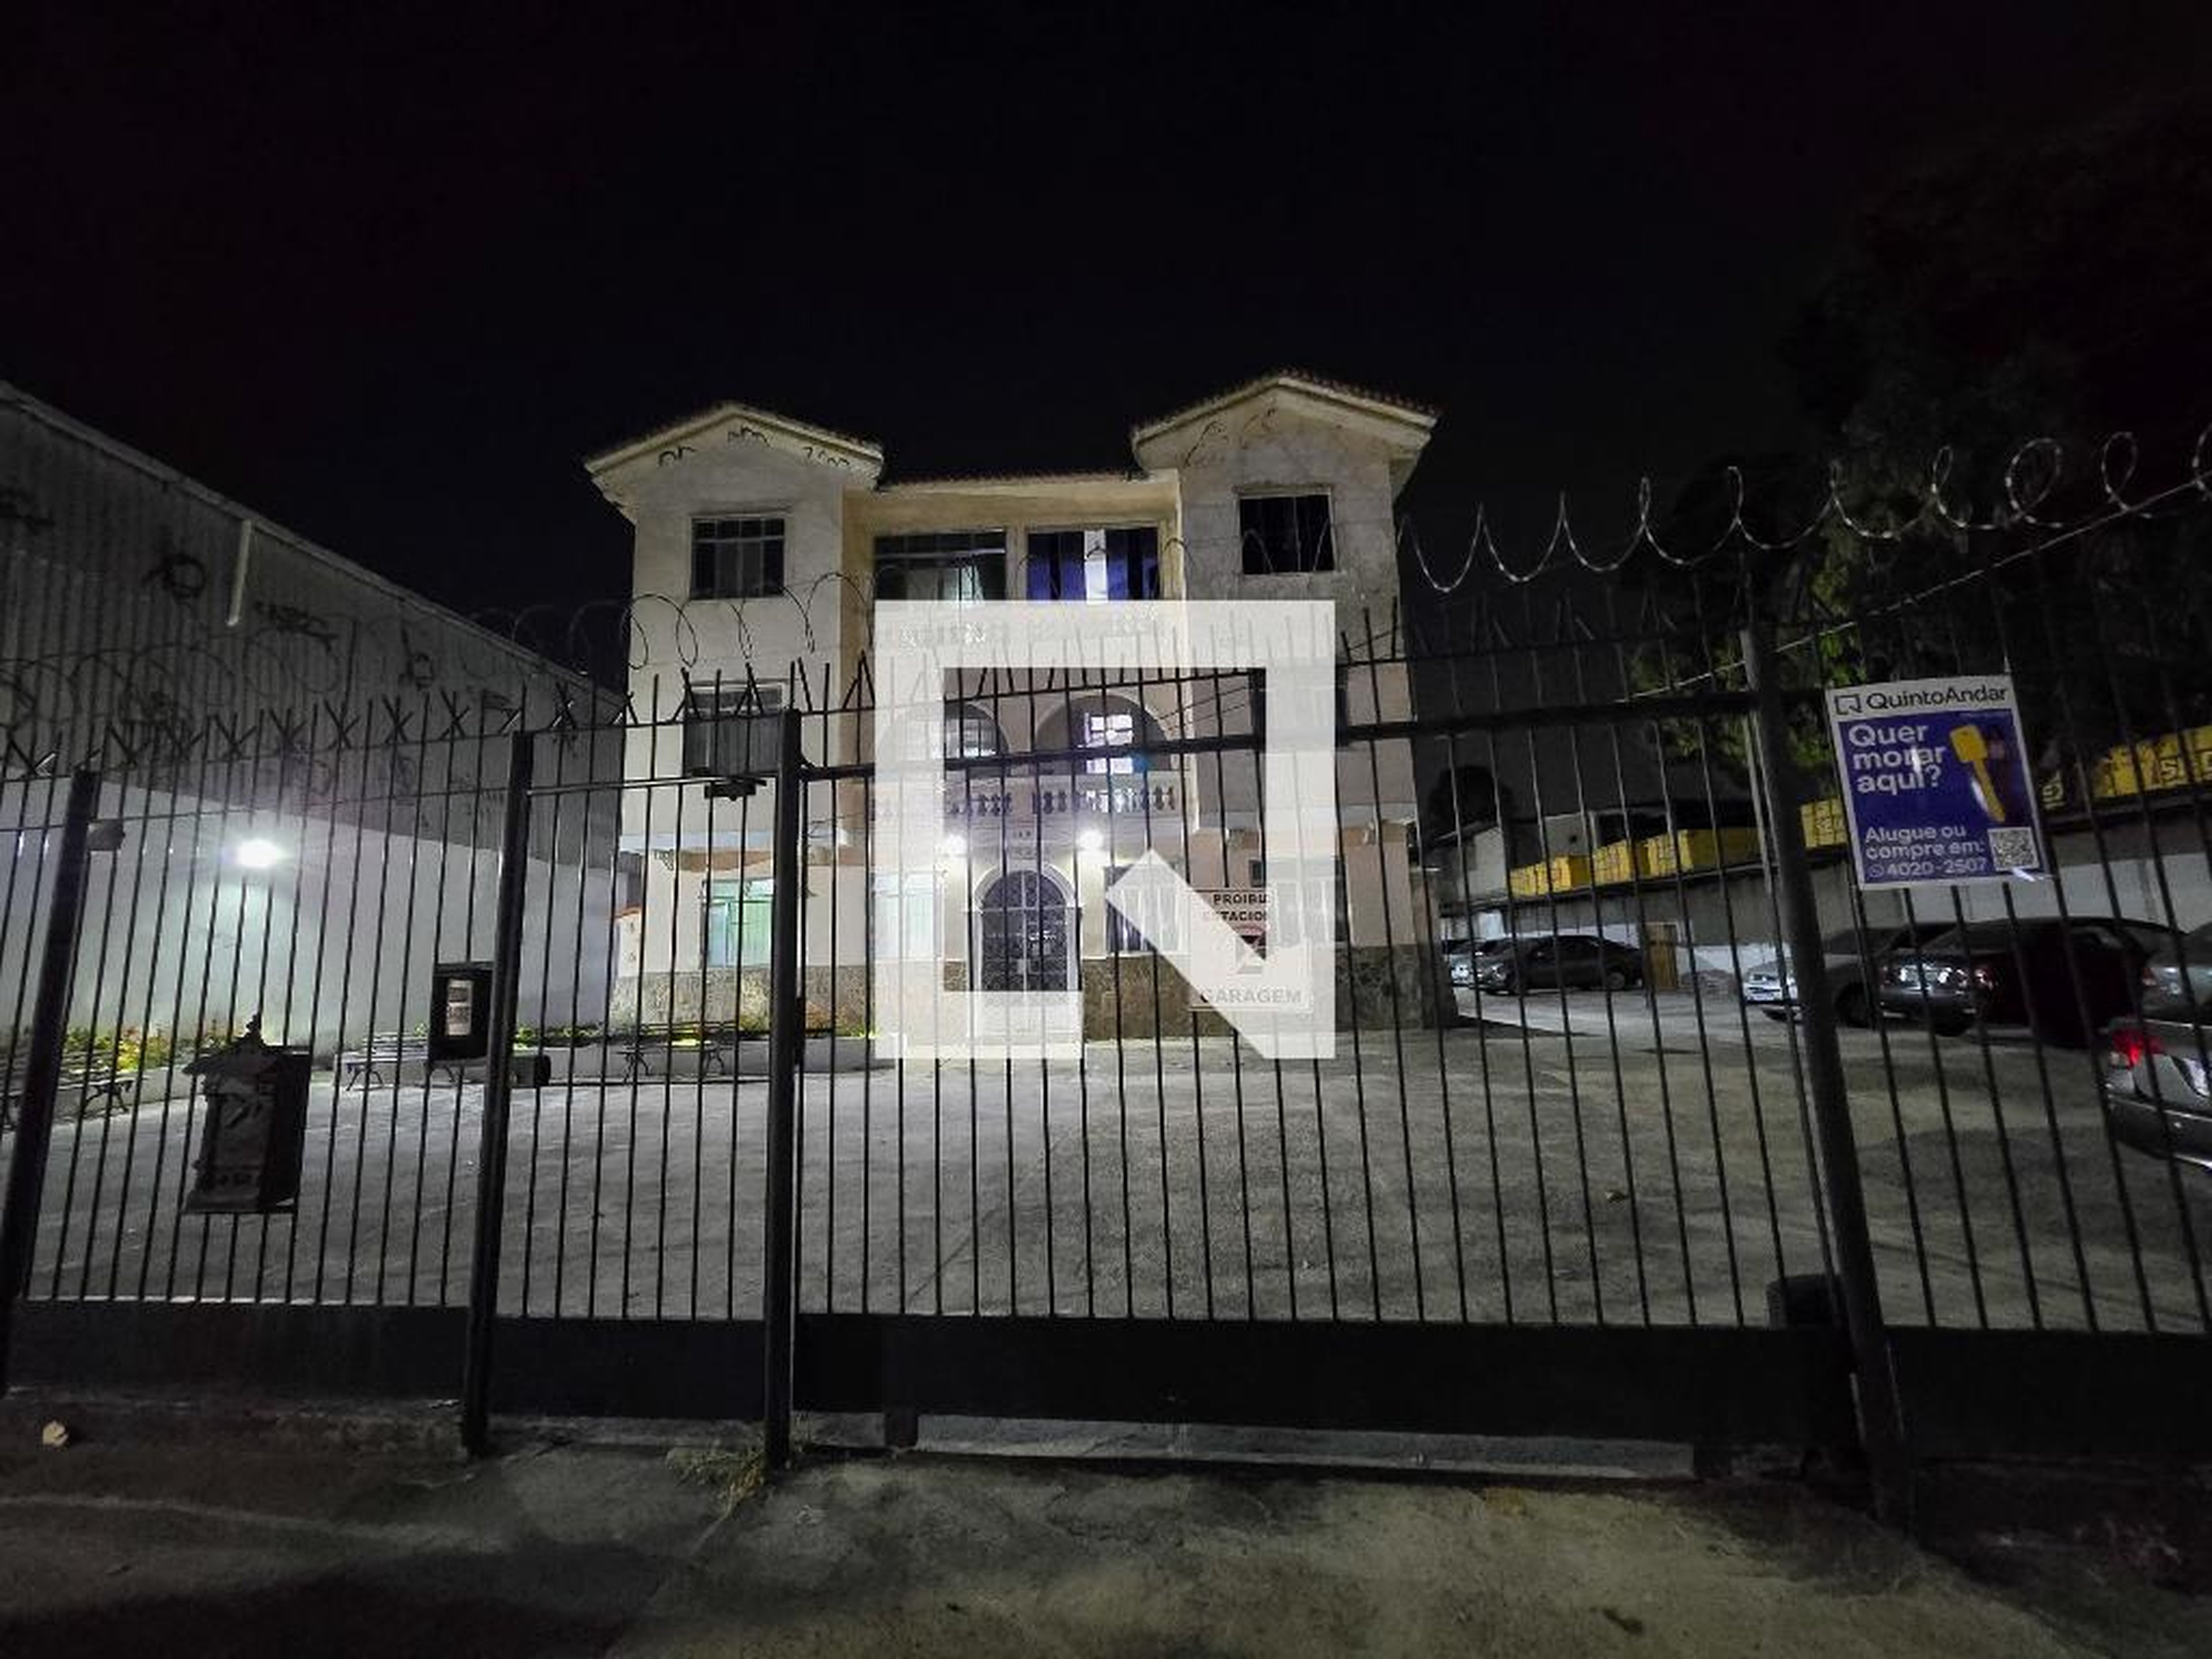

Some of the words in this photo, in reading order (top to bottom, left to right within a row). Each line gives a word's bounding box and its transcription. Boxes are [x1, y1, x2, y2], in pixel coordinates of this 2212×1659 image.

[1866, 685, 2008, 710] QuintoAndar
[1848, 724, 1929, 747] Quer
[1853, 746, 1946, 770] morar
[1857, 764, 1942, 796] aqui?
[1865, 826, 1937, 844] Alugue
[1941, 825, 1966, 838] ou
[1866, 843, 1945, 860] compre
[1949, 839, 1985, 854] em:
[1213, 893, 1266, 905] PROIBI
[1215, 911, 1266, 921] TACIO
